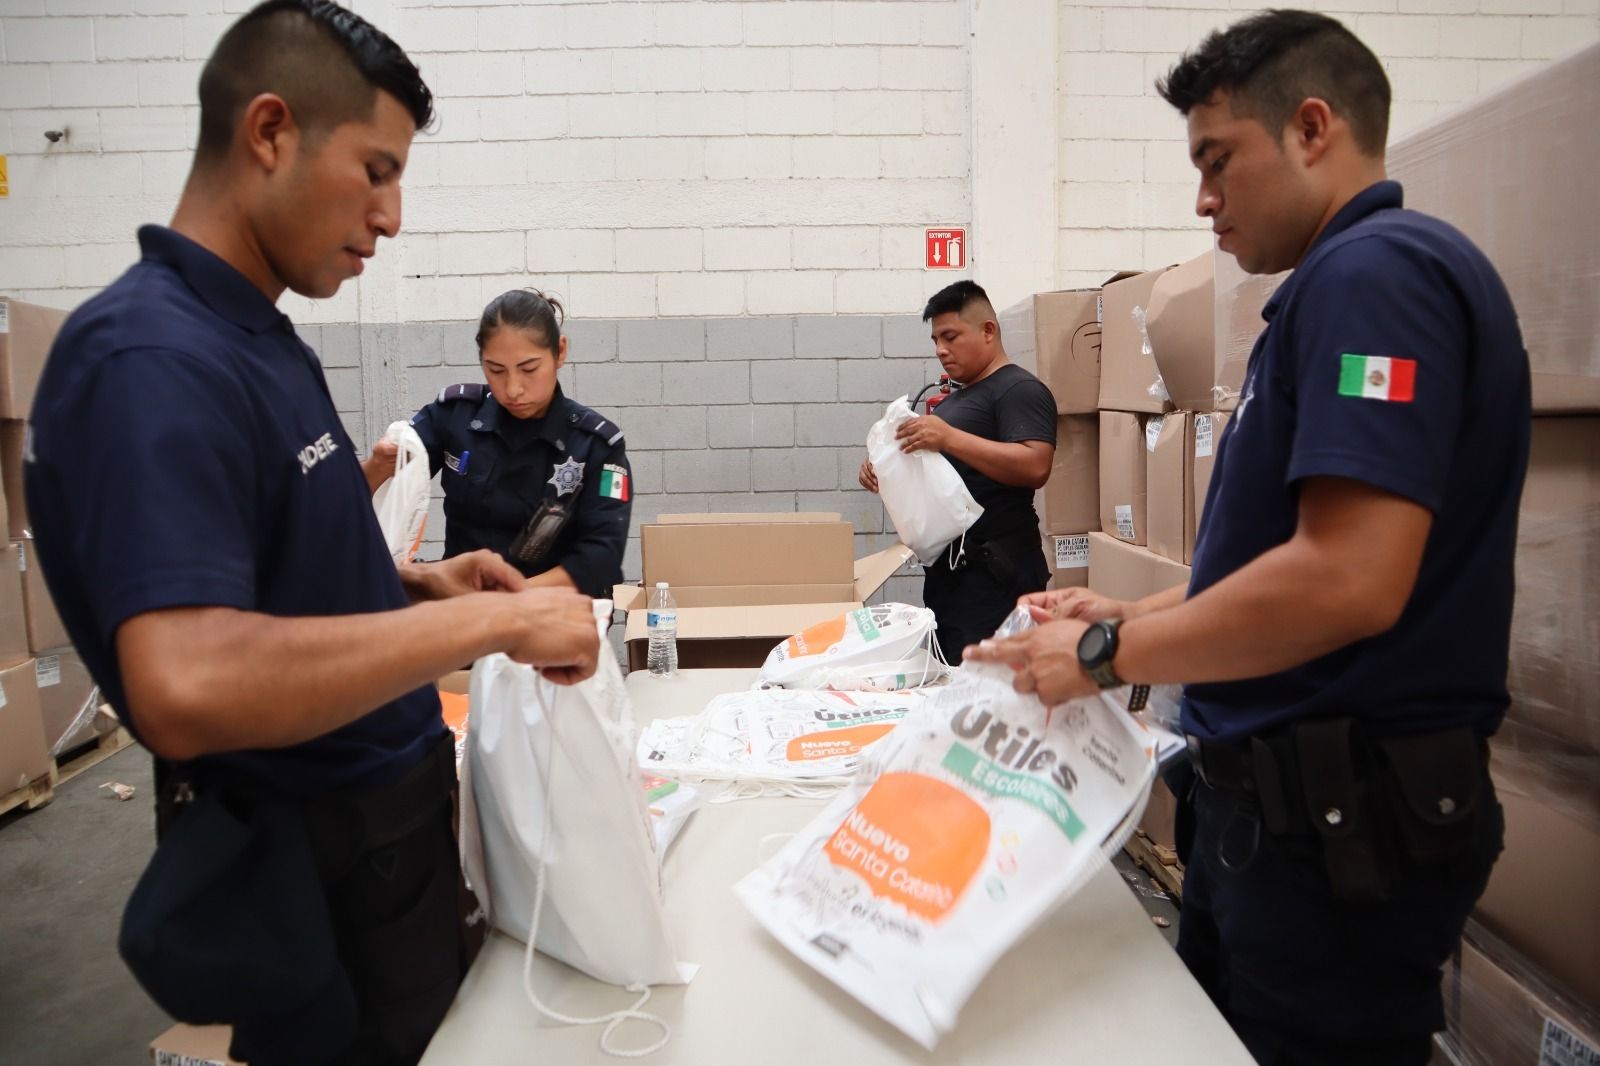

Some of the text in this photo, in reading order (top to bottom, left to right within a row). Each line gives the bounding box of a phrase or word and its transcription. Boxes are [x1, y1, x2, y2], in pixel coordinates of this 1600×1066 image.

[801, 740, 851, 750] Nuevo
[831, 829, 890, 880] Santa
[845, 809, 911, 863] Nuevo
